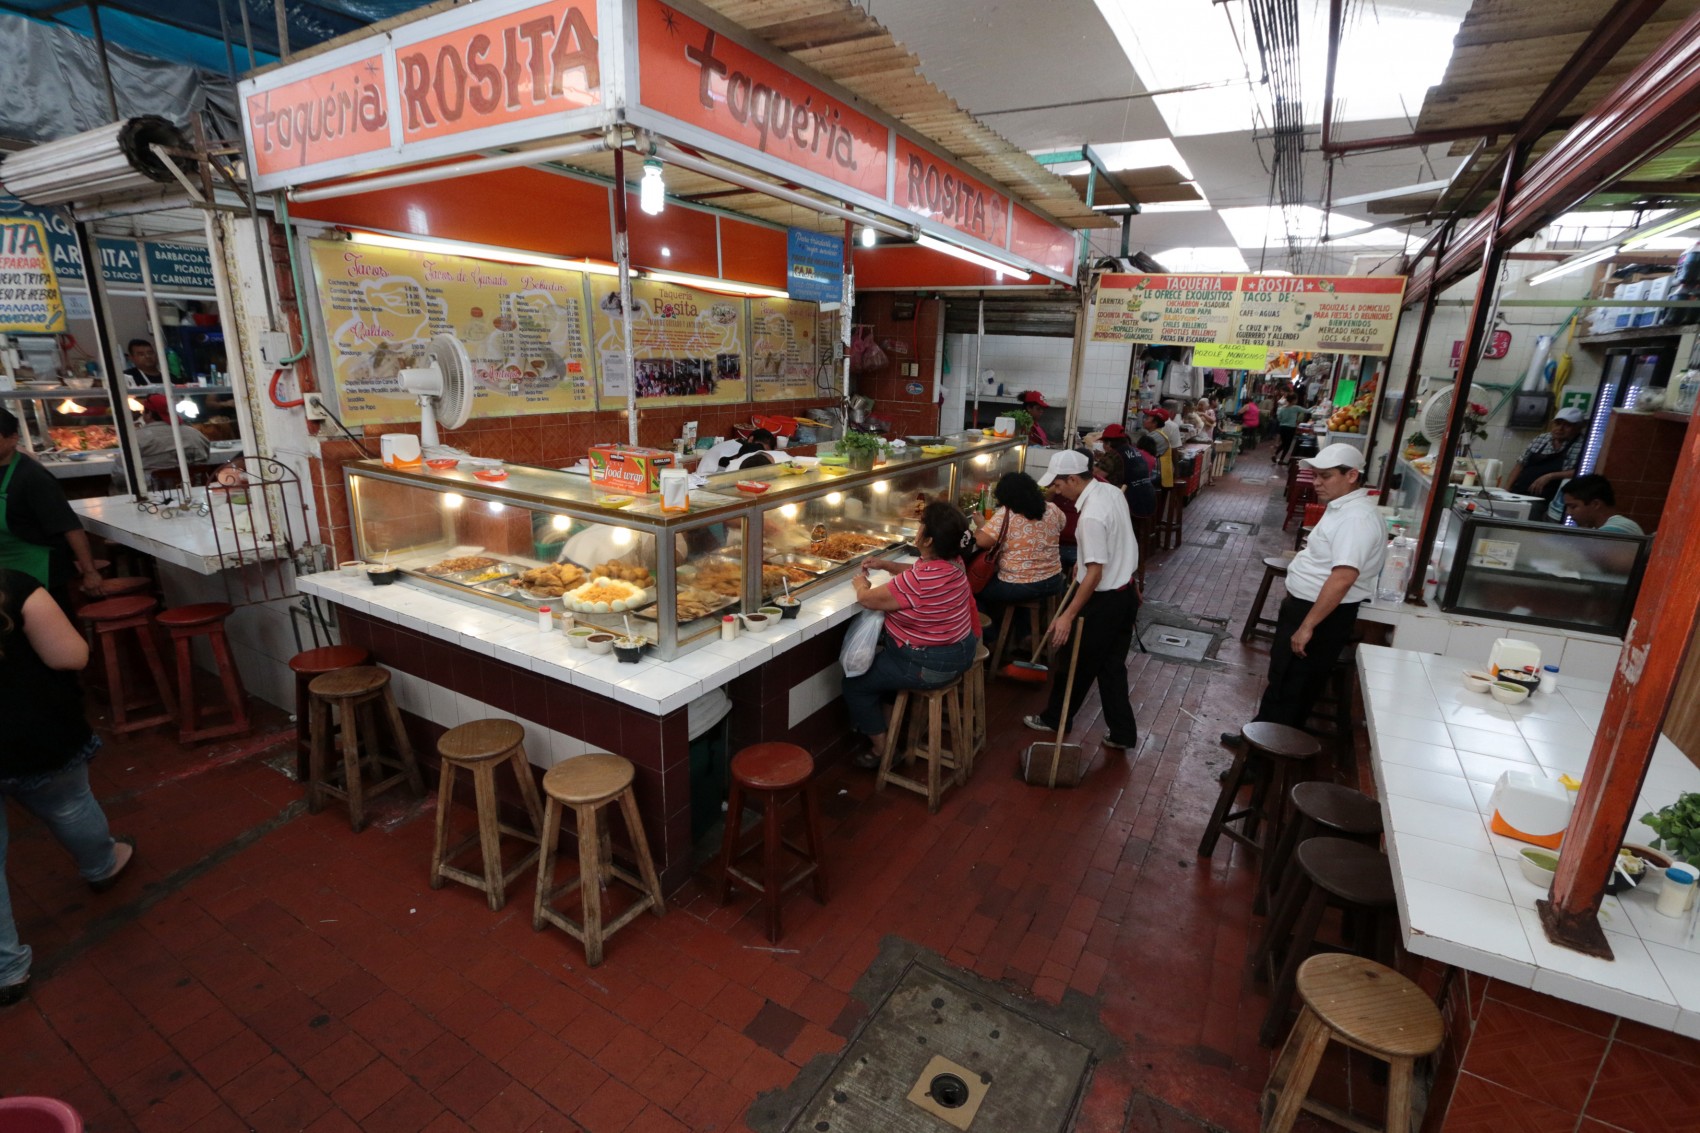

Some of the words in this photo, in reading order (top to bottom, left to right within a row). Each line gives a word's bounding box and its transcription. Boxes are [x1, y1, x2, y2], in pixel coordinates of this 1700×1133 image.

[401, 5, 601, 132] ROSITA
[907, 152, 986, 236] ROSITA
[155, 250, 203, 264] BARBACOA
[344, 252, 390, 278] Tacos
[423, 260, 454, 282] Tacos
[457, 268, 467, 283] de
[153, 273, 160, 282] Y
[161, 274, 202, 286] CARNITAS
[1167, 277, 1222, 291] TAQUERIA
[1257, 279, 1304, 292] ROSITA
[1144, 290, 1152, 299] LE
[1154, 290, 1182, 301] OFRECE
[1185, 291, 1232, 302] EXQUISITOS
[1243, 292, 1271, 302] TACOS
[1278, 292, 1295, 302] DE:
[1191, 329, 1217, 337] RELLENOS
[1236, 331, 1266, 339] (GUERRERO
[1318, 326, 1348, 334] MERCADO
[1350, 327, 1378, 335] HIDALGO
[1219, 343, 1246, 351] CALDOS
[1195, 349, 1222, 357] POZOLE
[1226, 351, 1265, 360] MONDONGO
[604, 465, 622, 480] food
[624, 471, 643, 486] wrap
